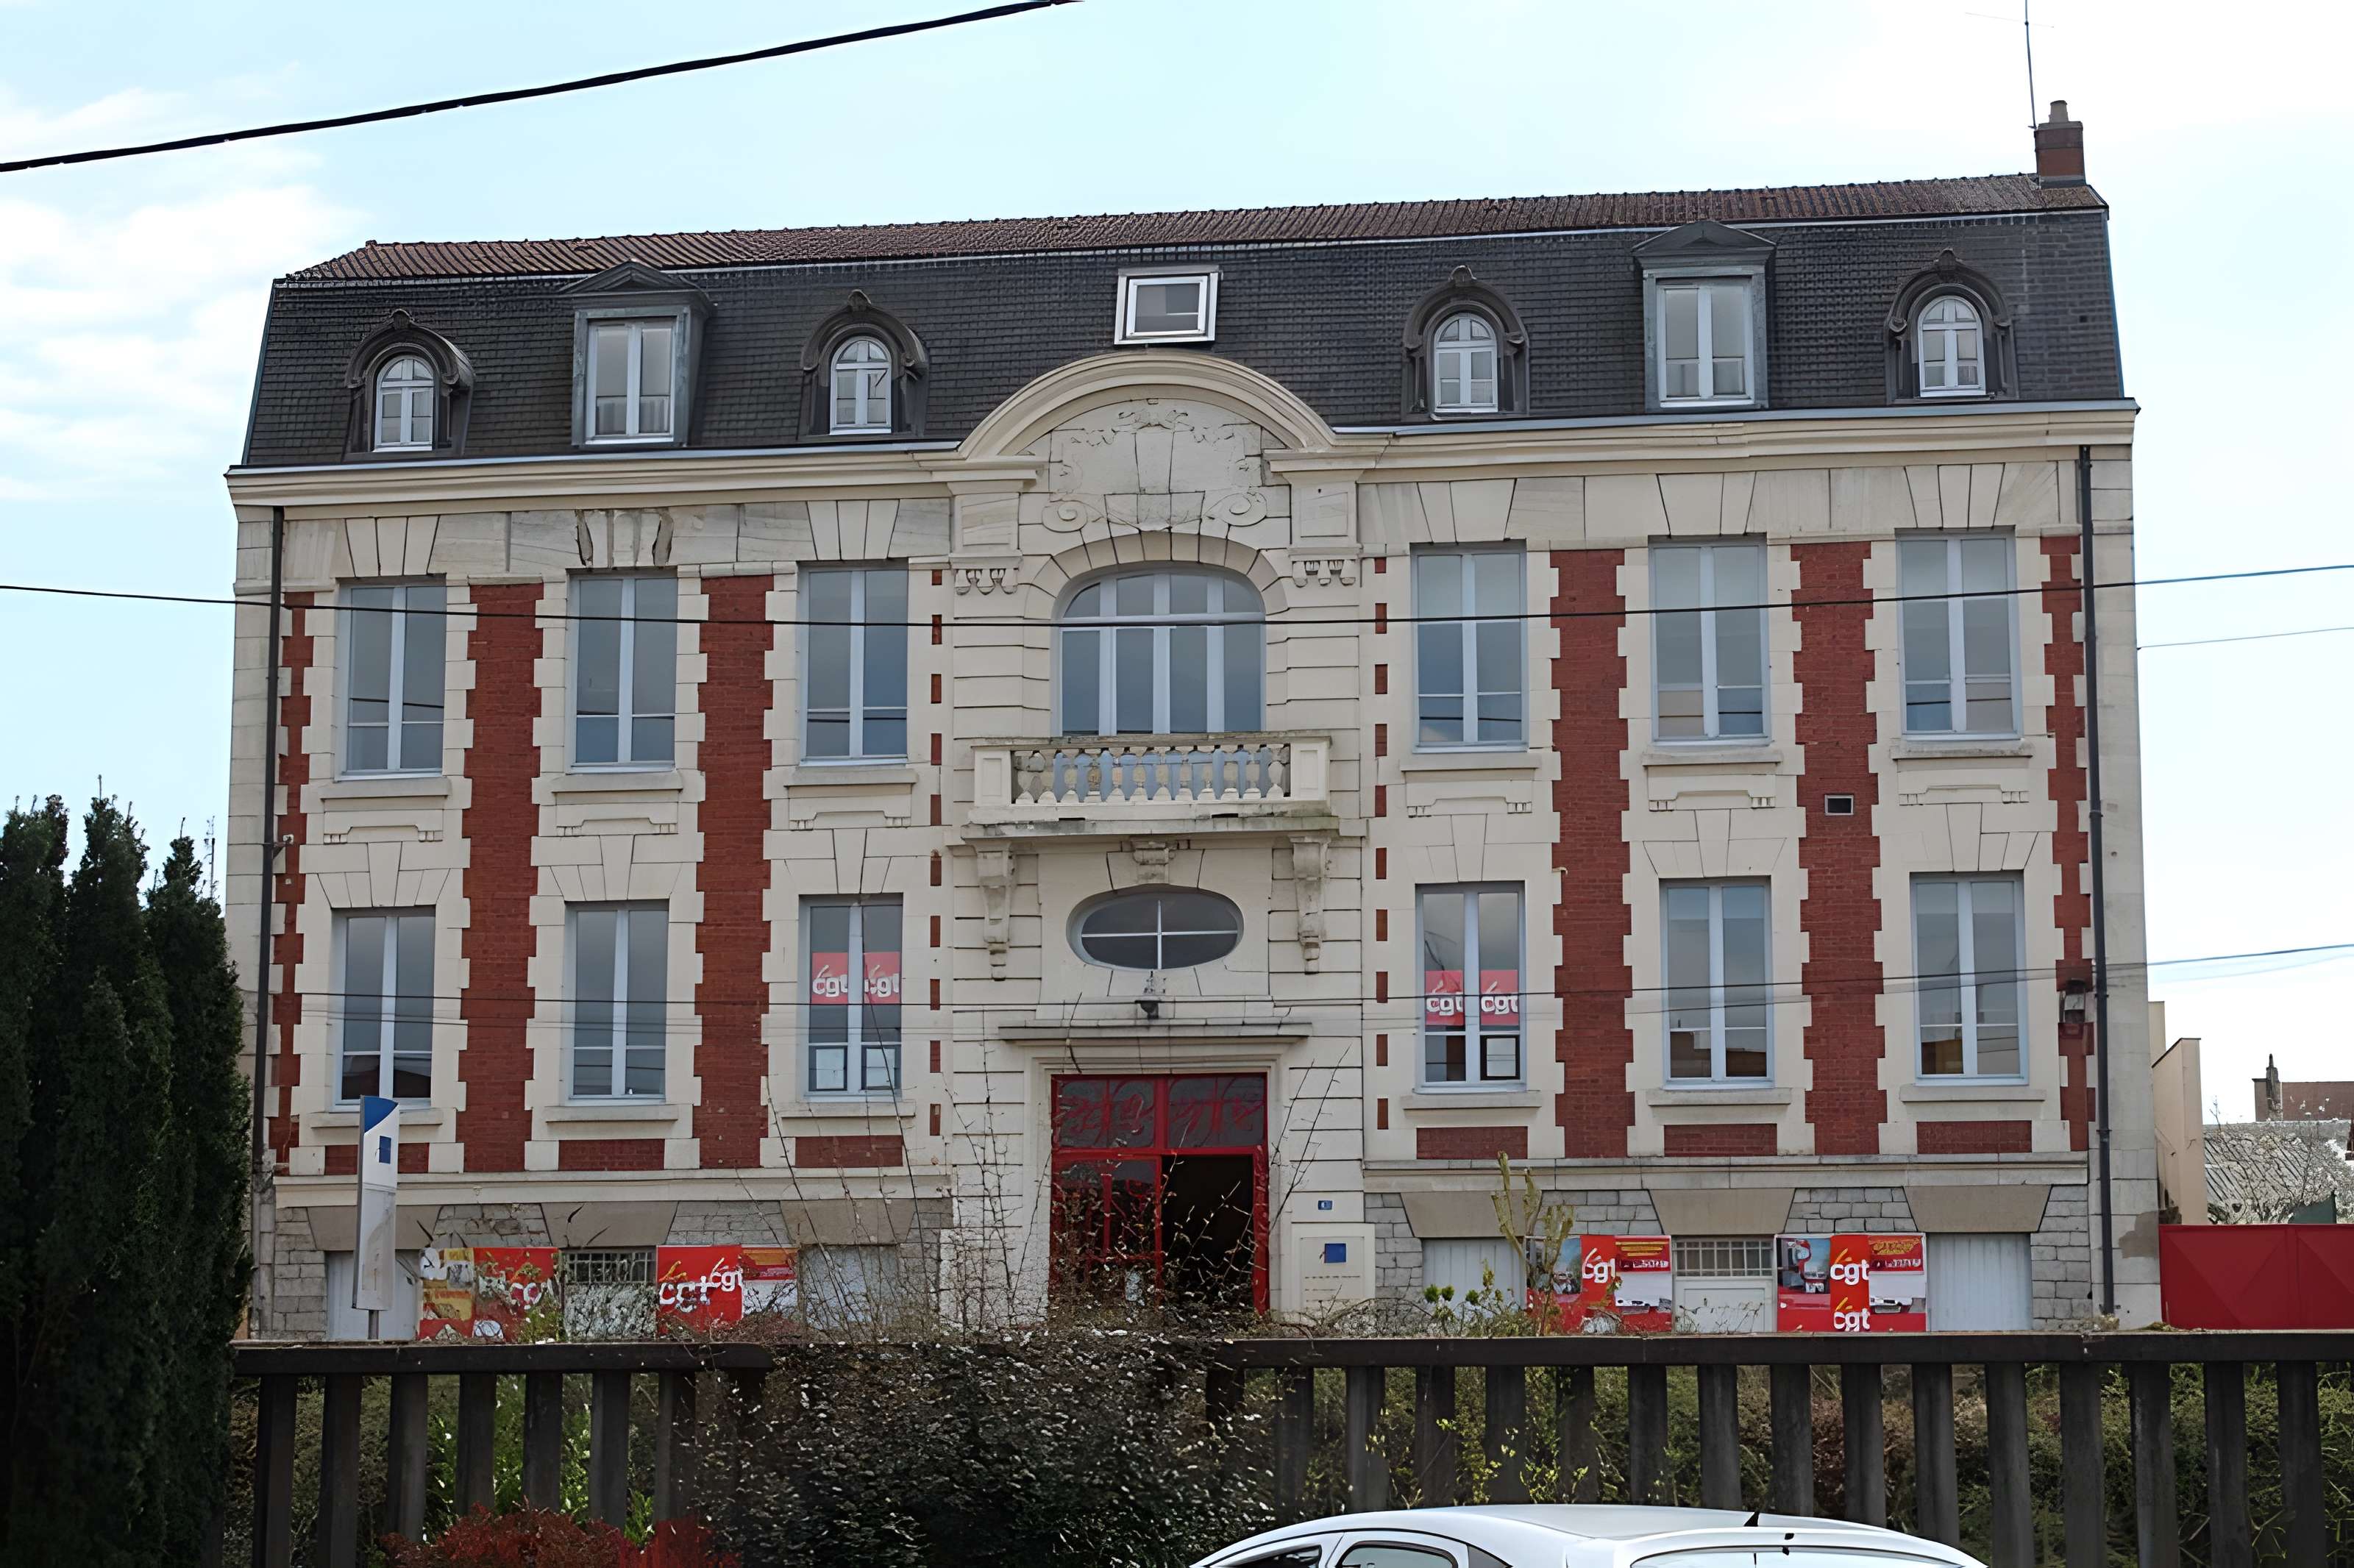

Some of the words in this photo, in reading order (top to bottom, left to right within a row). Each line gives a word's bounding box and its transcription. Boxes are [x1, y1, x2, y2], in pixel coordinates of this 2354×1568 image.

[1481, 994, 1518, 1014] cgt
[1830, 1259, 1869, 1285] cgt
[1833, 1308, 1870, 1332] cgt
